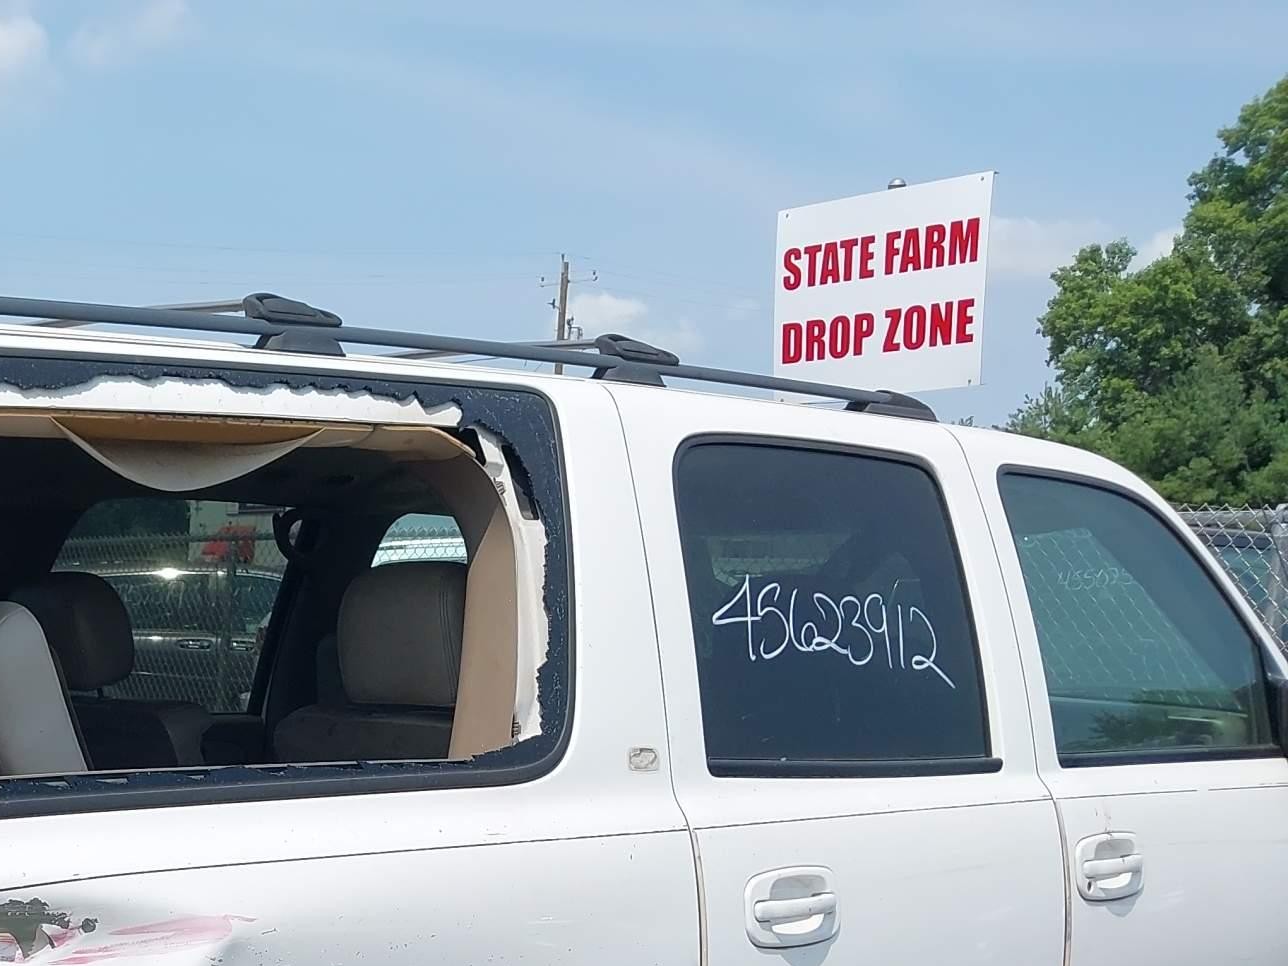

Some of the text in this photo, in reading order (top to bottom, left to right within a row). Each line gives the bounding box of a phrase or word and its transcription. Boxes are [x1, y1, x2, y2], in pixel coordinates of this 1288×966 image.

[783, 217, 980, 291] STATE FARM
[781, 298, 975, 365] DROP ZONE
[712, 574, 956, 688] 45623912
